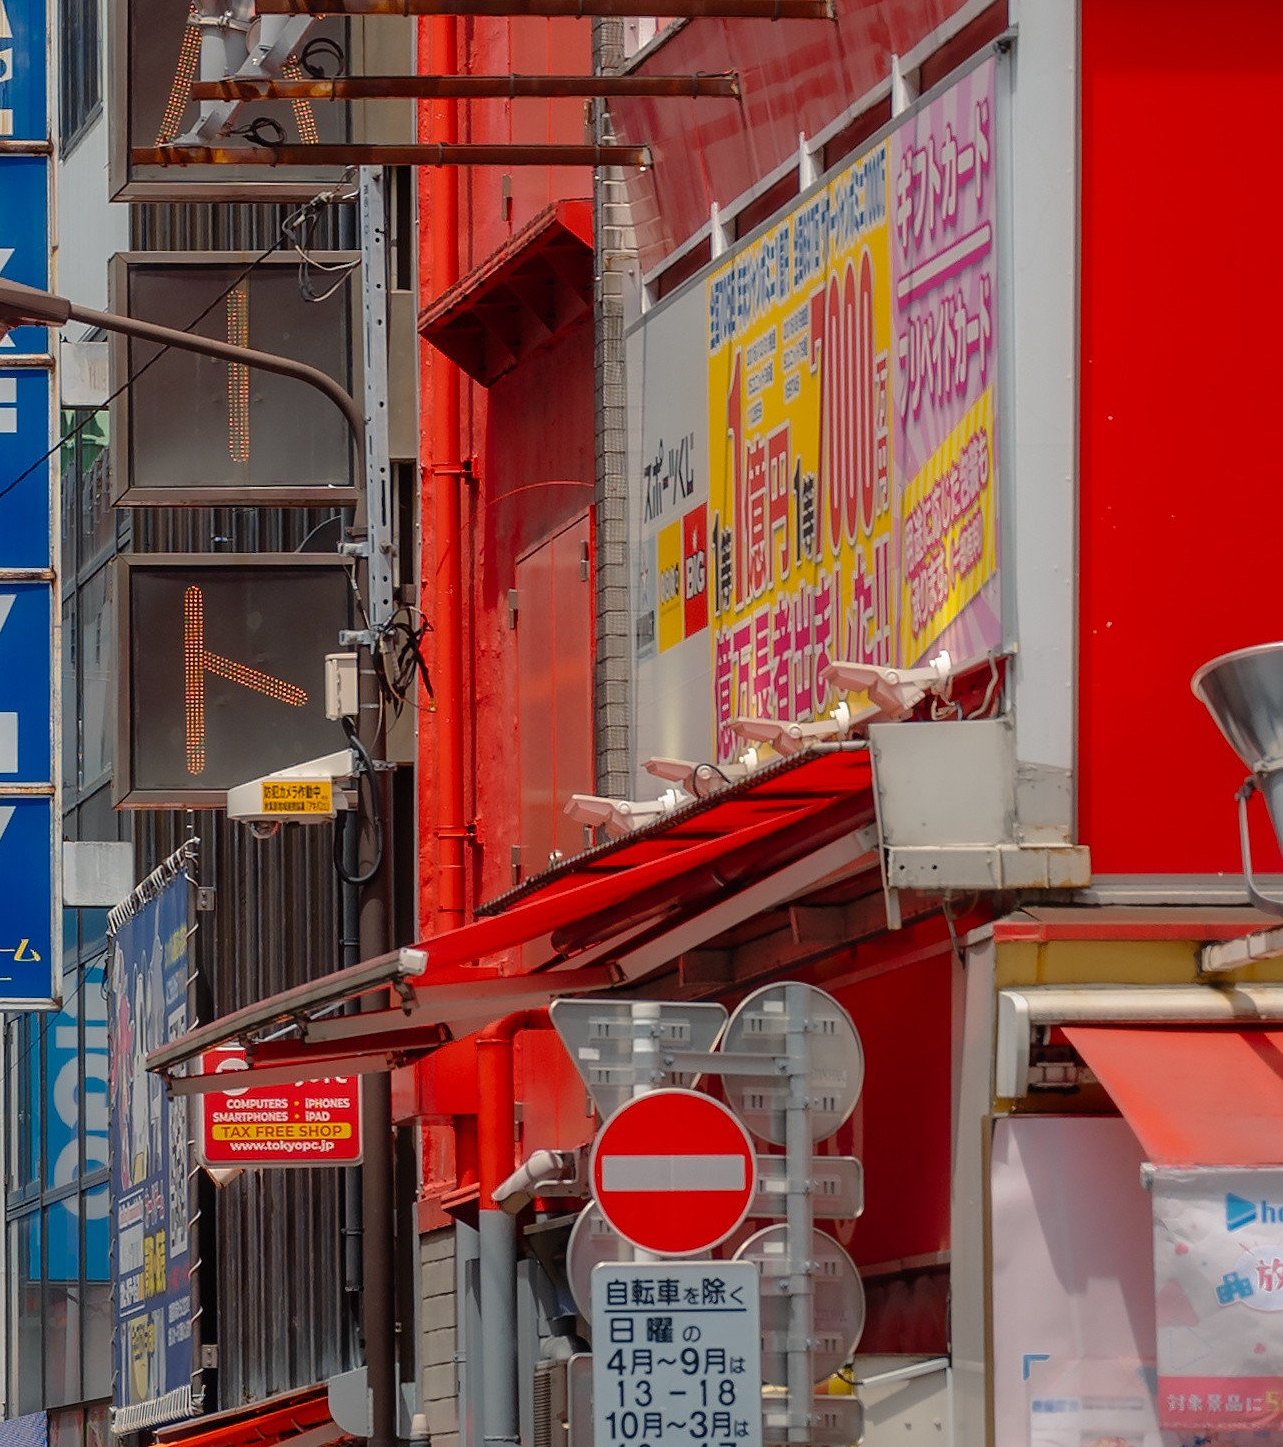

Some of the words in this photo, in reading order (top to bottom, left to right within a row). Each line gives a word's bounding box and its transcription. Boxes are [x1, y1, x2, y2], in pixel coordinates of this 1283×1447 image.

[895, 97, 992, 252] ギフトカード
[226, 1098, 289, 1110] COMPUTERS
[212, 1111, 289, 1123] SMARTPHONES
[221, 1126, 251, 1138] TAX
[256, 1125, 294, 1138] FREE
[299, 1125, 343, 1137] SHOP
[229, 1139, 335, 1153] www.tokyopc.jp
[605, 1277, 745, 1307] 自転車を除く
[609, 1316, 703, 1345] 日曜の
